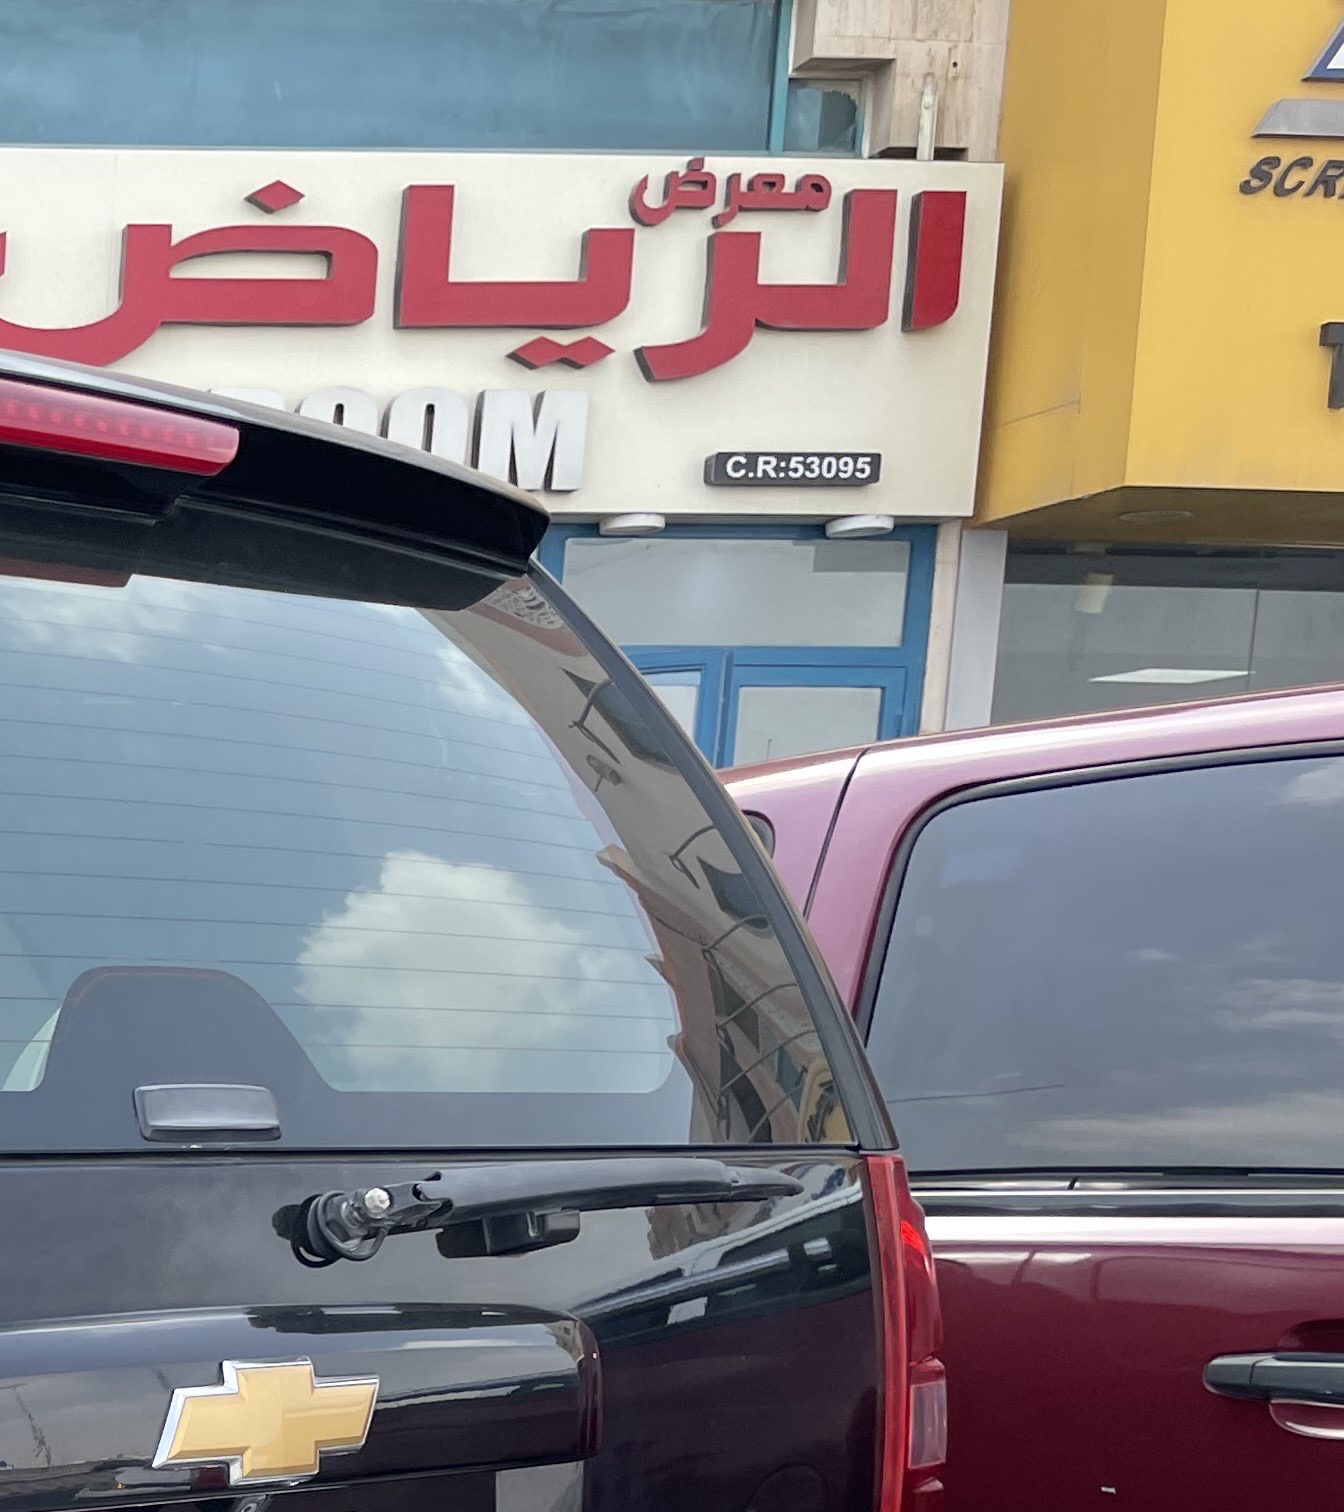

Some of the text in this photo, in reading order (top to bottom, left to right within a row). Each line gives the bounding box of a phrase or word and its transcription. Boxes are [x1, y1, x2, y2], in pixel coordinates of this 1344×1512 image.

[629, 157, 832, 229] معرض
[1239, 156, 1344, 199] SCR
[726, 455, 872, 479] C.R:53095
